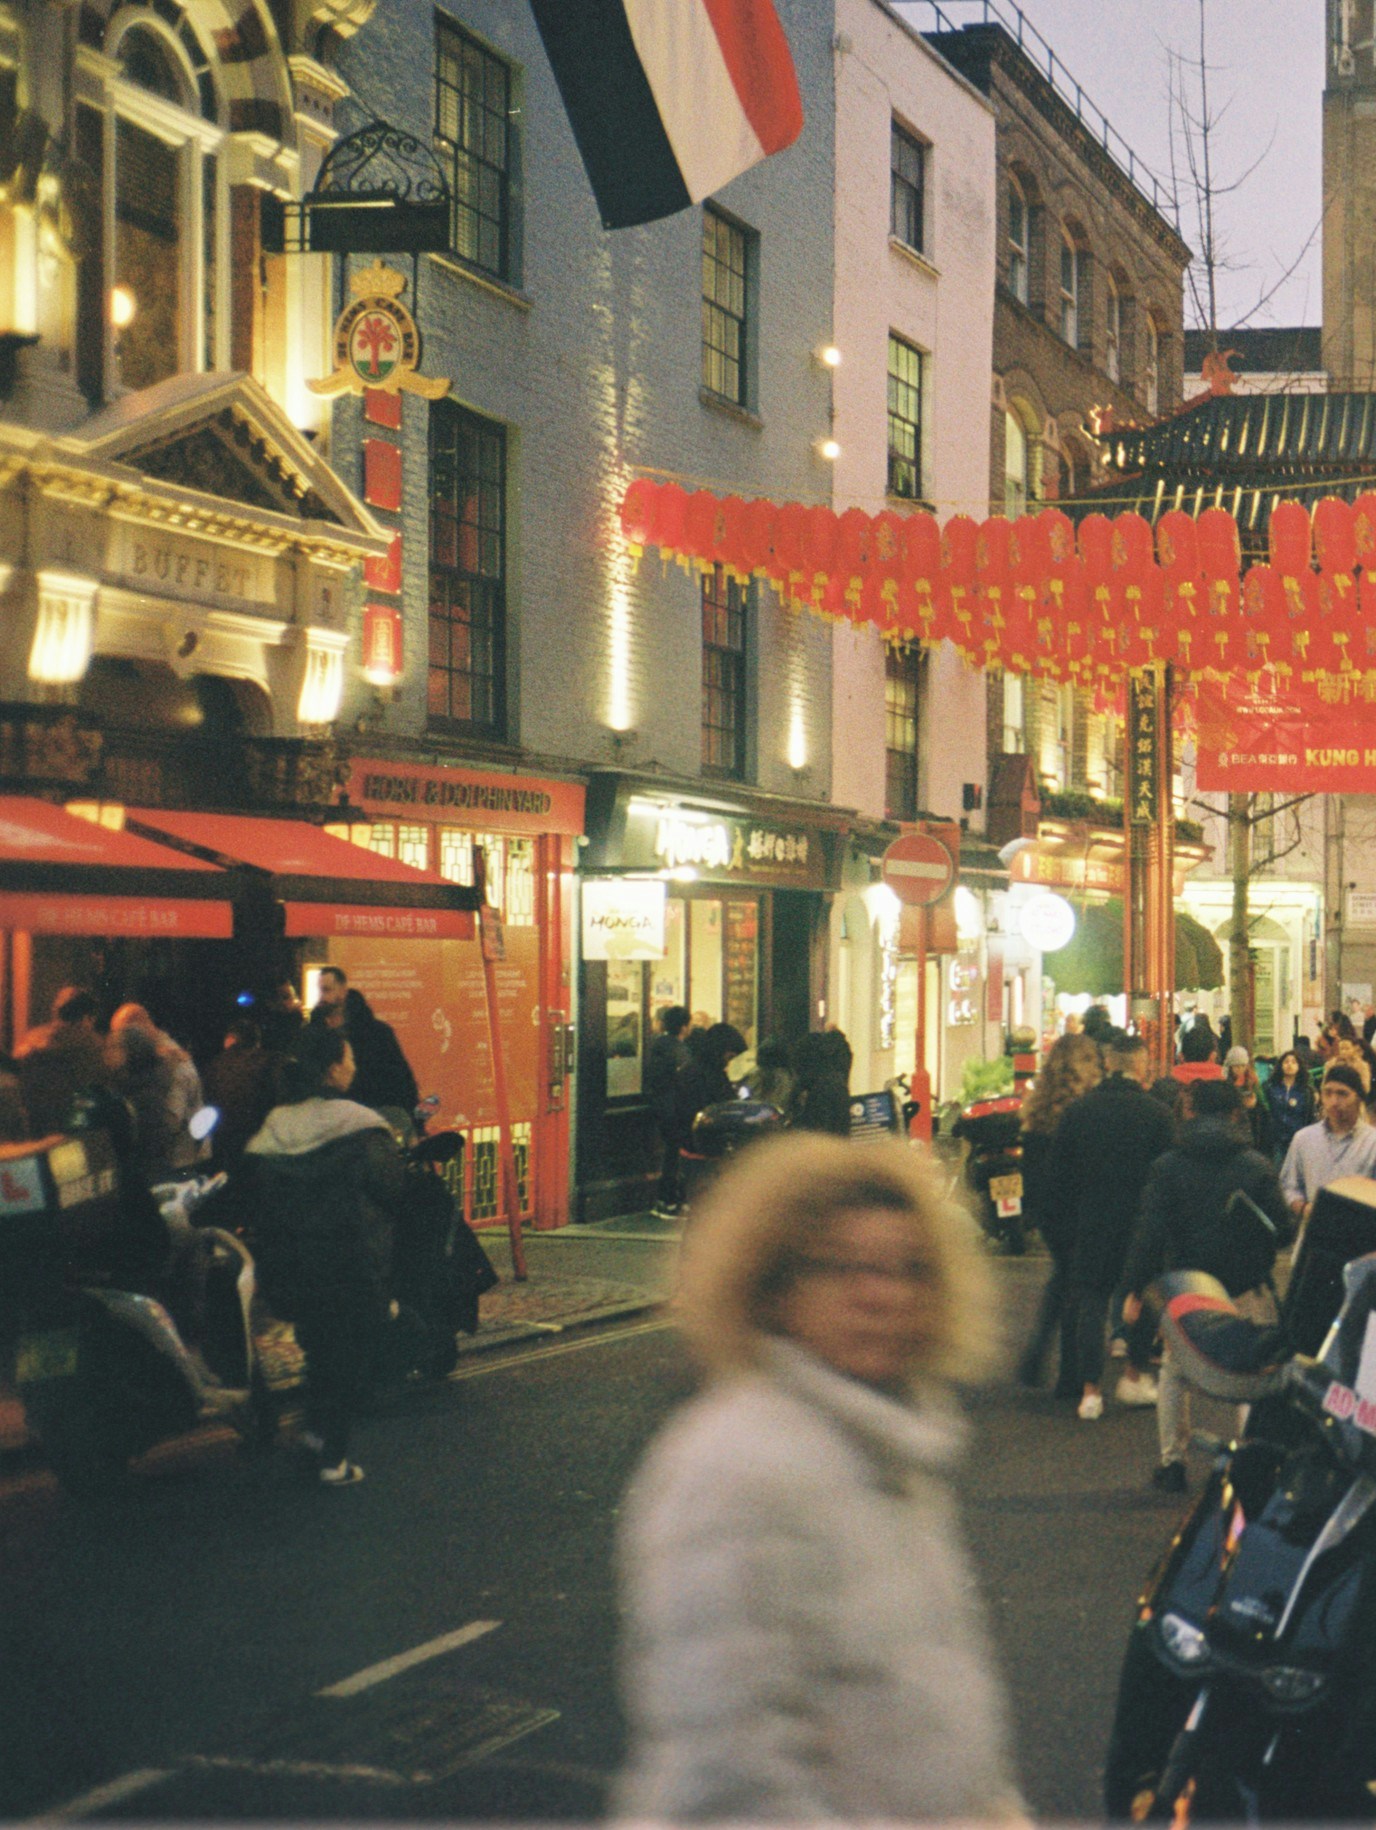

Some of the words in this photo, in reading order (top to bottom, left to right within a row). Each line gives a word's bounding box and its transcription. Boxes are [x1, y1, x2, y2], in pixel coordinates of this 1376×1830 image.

[133, 544, 249, 596] BUFFET
[1231, 754, 1257, 765] BEA
[1305, 748, 1360, 767] KUNG
[424, 778, 439, 804] &
[440, 780, 512, 811] DOLPHIN
[512, 788, 552, 815] YARD
[335, 914, 349, 930] DE
[353, 915, 385, 931] HEMS
[386, 914, 413, 932] CAFÉ
[416, 917, 437, 933] BAR
[591, 916, 652, 931] MONGA
[1002, 1198, 1017, 1212] L
